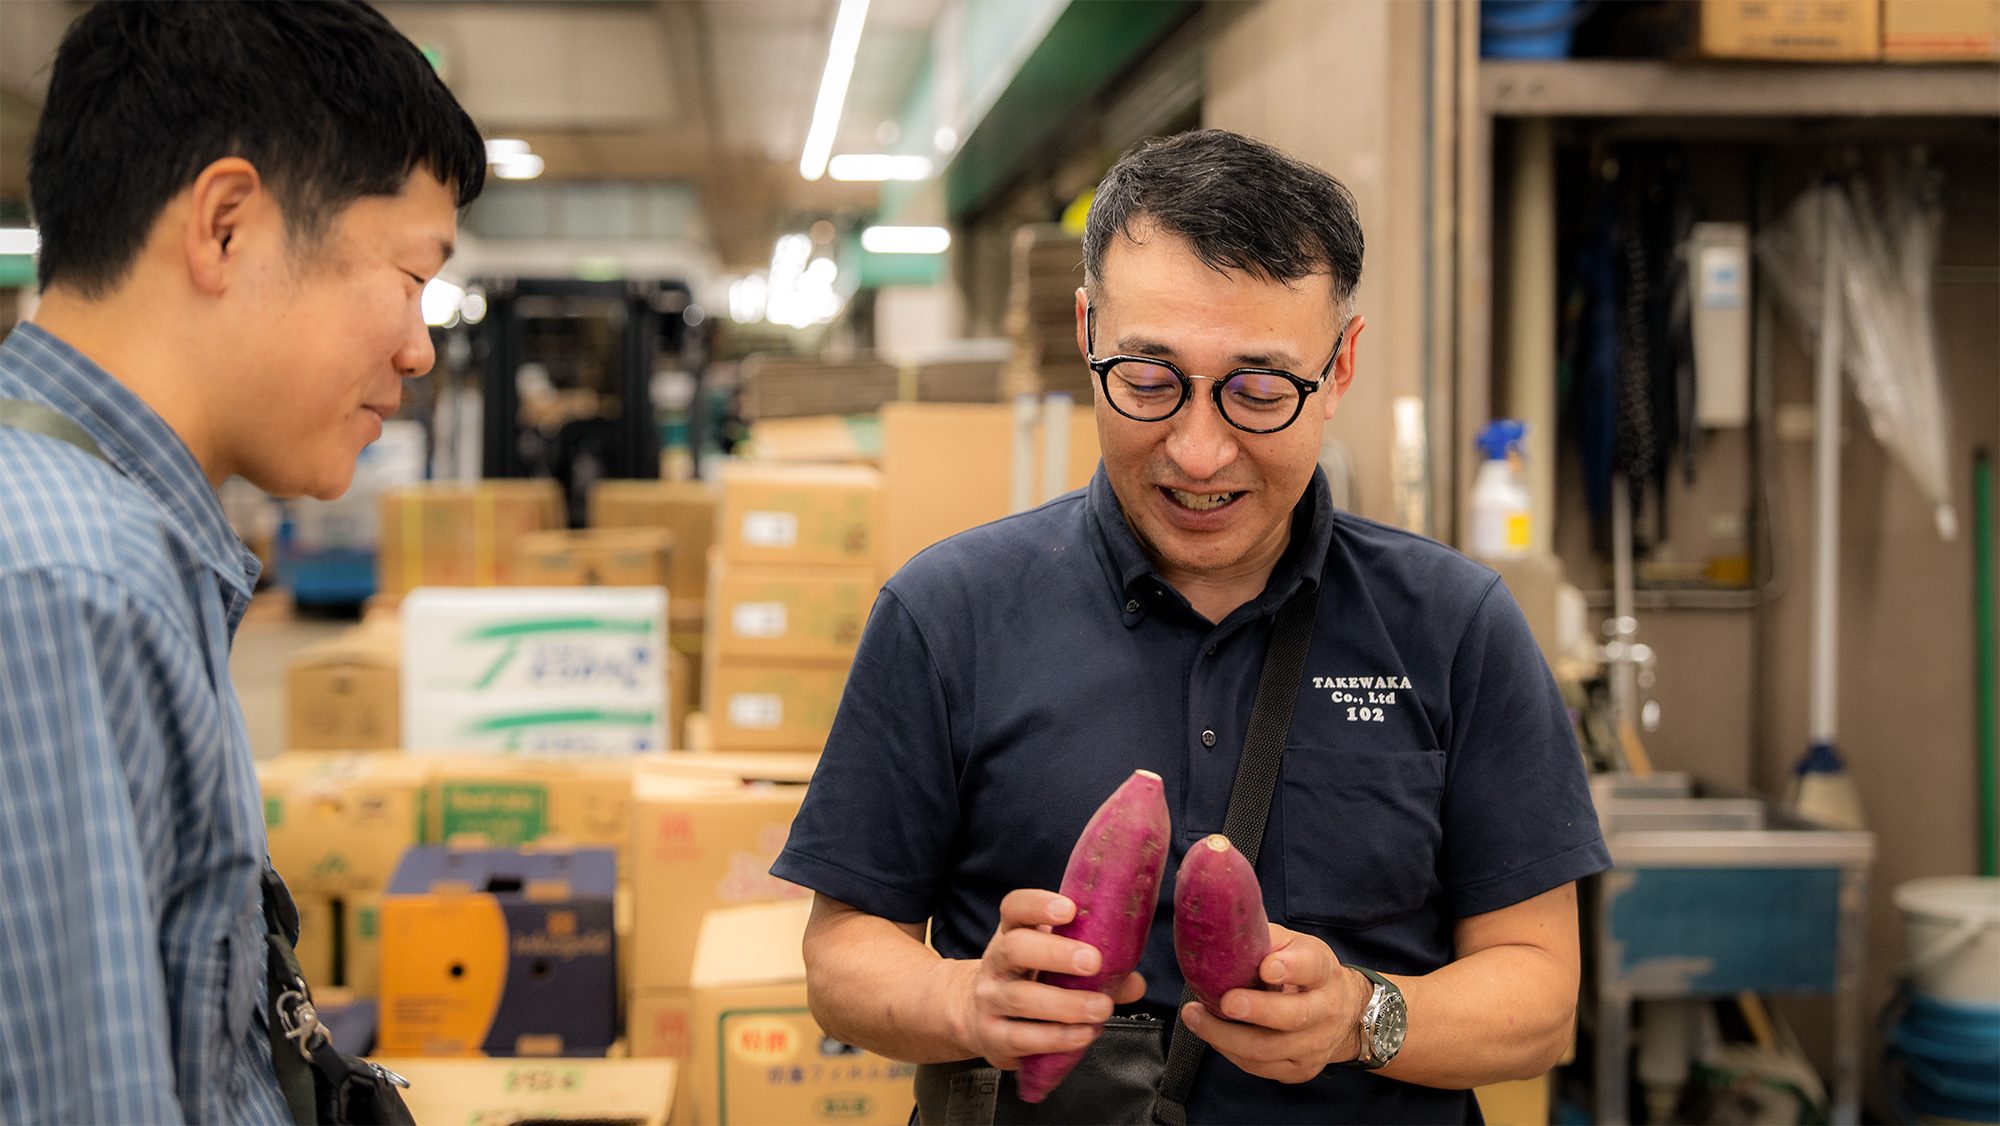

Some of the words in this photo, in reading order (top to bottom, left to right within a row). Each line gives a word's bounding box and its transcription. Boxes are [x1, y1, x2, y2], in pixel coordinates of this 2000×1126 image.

[1312, 676, 1412, 689] TAKEWAKA
[1331, 691, 1363, 705] Co.,
[1368, 691, 1396, 705] Ltd
[1346, 706, 1385, 722] 102
